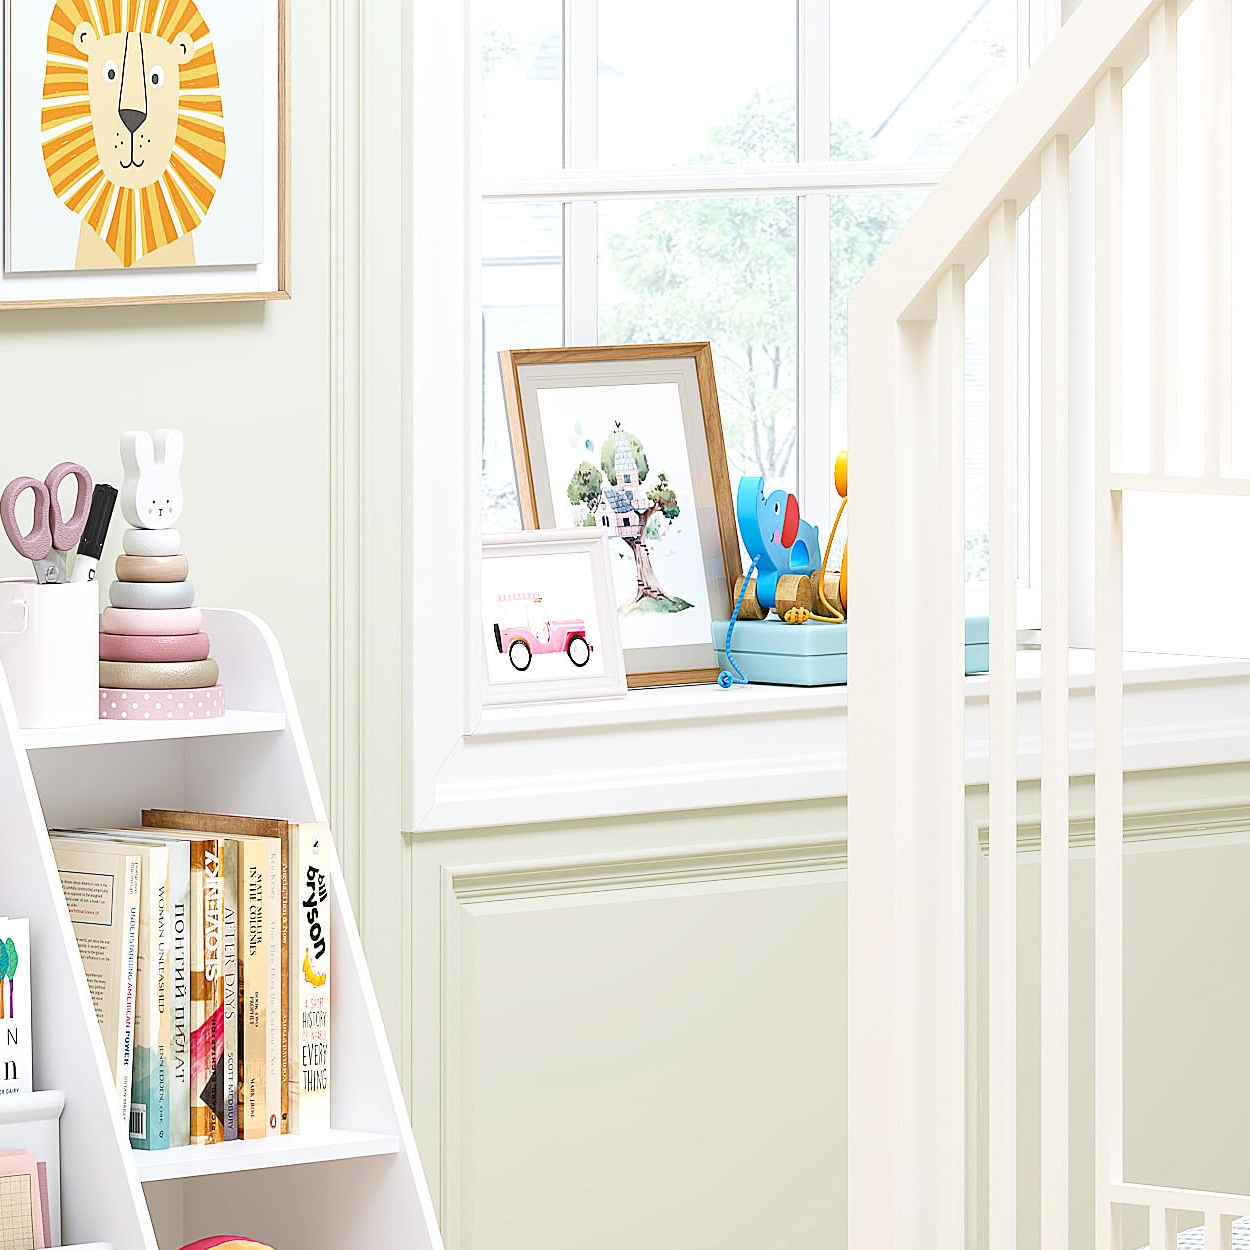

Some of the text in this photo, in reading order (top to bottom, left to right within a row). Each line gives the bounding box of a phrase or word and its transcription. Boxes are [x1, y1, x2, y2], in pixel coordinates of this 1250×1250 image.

[317, 874, 328, 903] bill
[302, 865, 326, 960] bryson
[224, 907, 235, 1020] AFTER DAYS
[174, 904, 187, 1083] ПОНТИЙ ПИЛАТ
[123, 1030, 131, 1066] POWER
[302, 1043, 328, 1066] EVERY
[302, 1068, 327, 1092] THING
